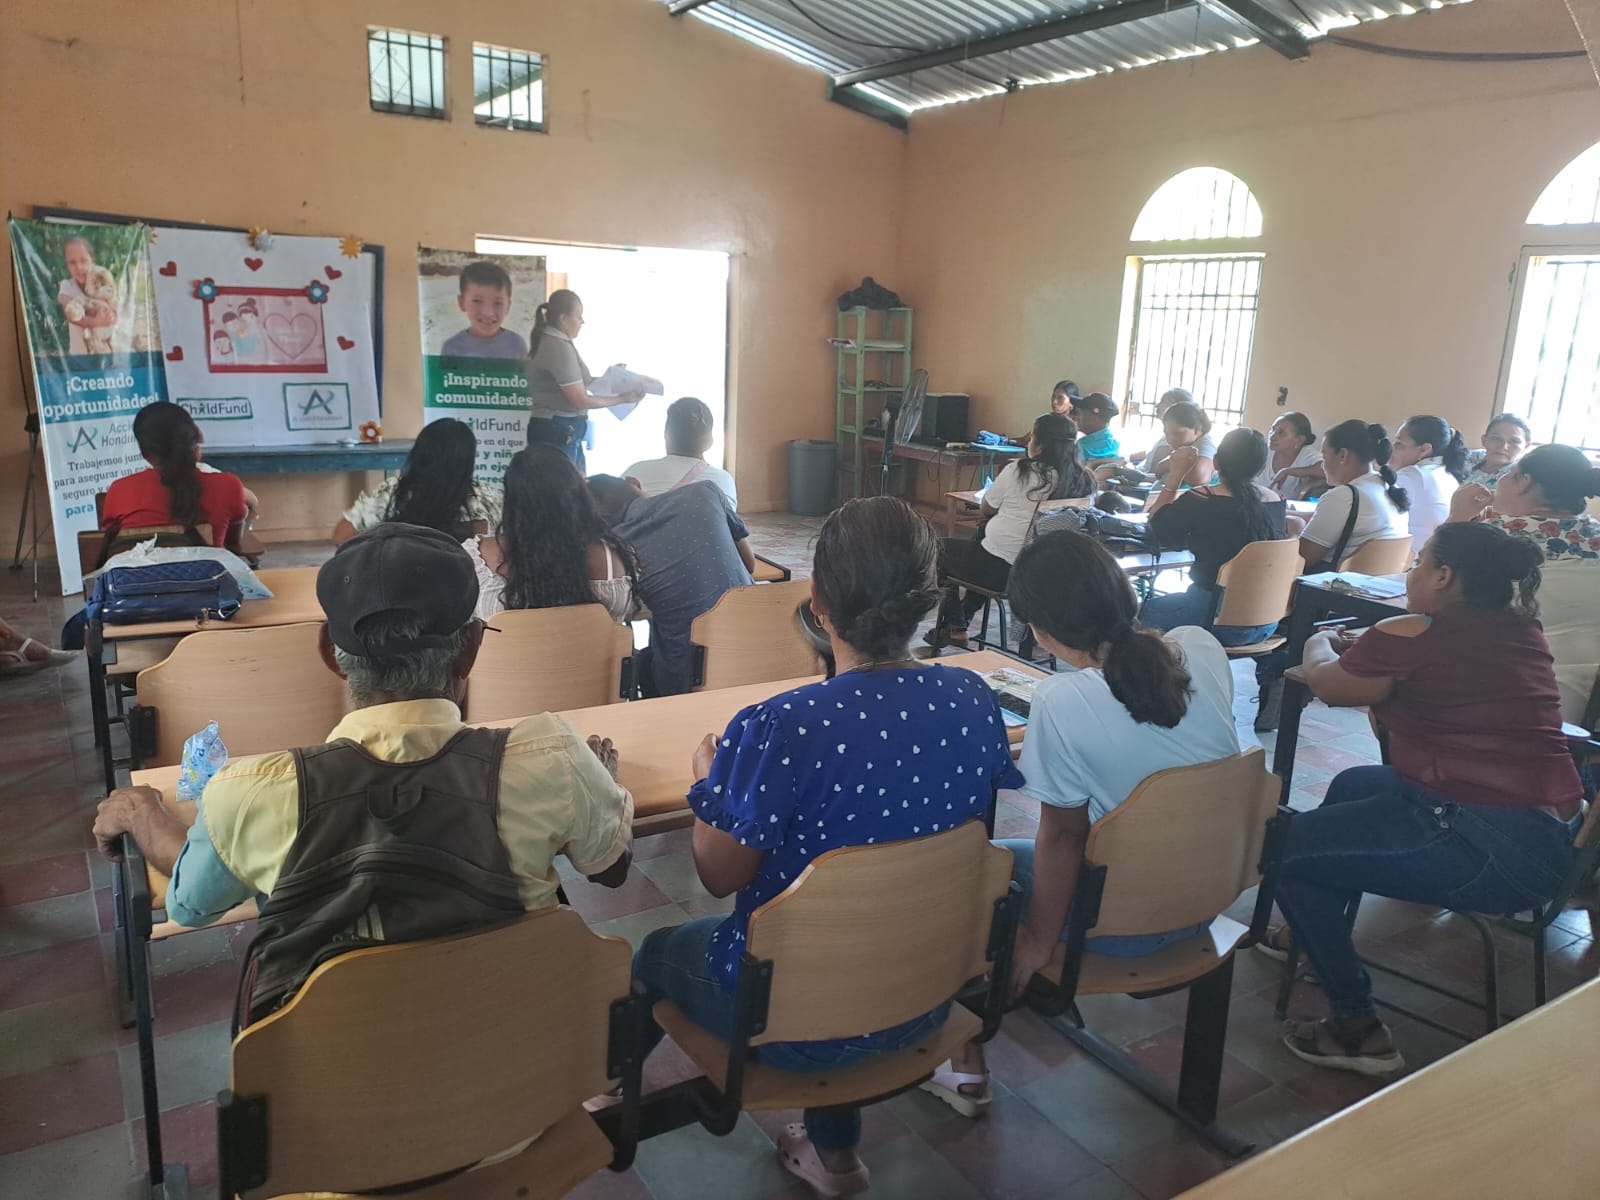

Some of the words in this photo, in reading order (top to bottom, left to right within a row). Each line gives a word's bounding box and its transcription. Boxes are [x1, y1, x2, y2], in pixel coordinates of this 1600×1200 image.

[66, 373, 134, 396] ¡Creando
[443, 372, 528, 389] ¡Inspirando
[435, 392, 534, 406] comunidades
[109, 420, 133, 433] Acci
[494, 449, 512, 458] niñ
[68, 456, 122, 472] Trabajemos
[54, 478, 76, 491] para
[78, 470, 118, 483] asegurar
[62, 487, 96, 501] seguro
[65, 503, 94, 519] para
